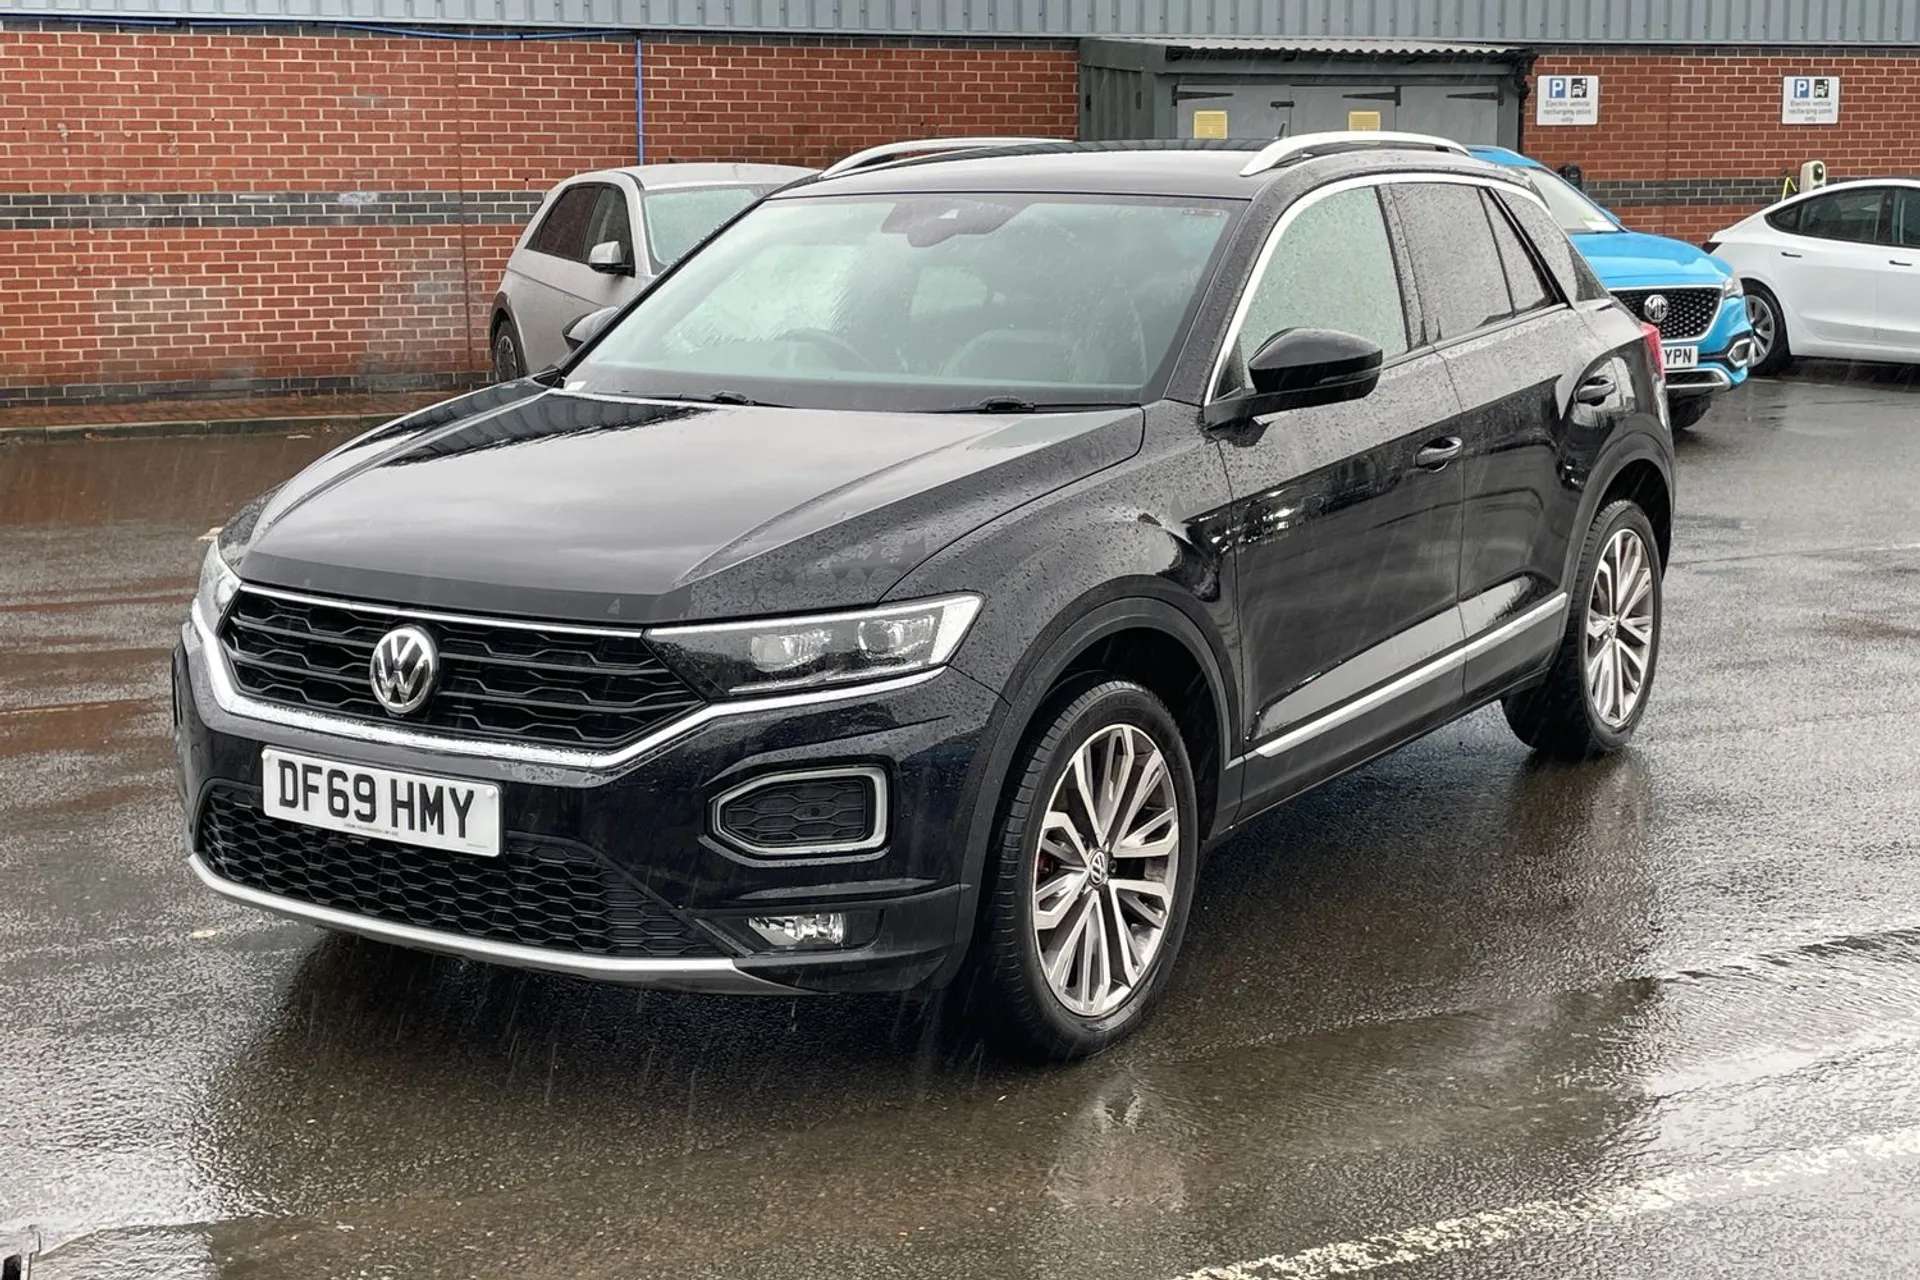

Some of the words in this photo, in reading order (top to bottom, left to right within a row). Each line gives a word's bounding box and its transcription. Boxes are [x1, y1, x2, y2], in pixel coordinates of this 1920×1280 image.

[1552, 80, 1564, 97] P
[1797, 80, 1808, 97] P
[1664, 348, 1692, 365] YPN
[278, 759, 377, 823] DF69
[390, 778, 475, 839] HMY
